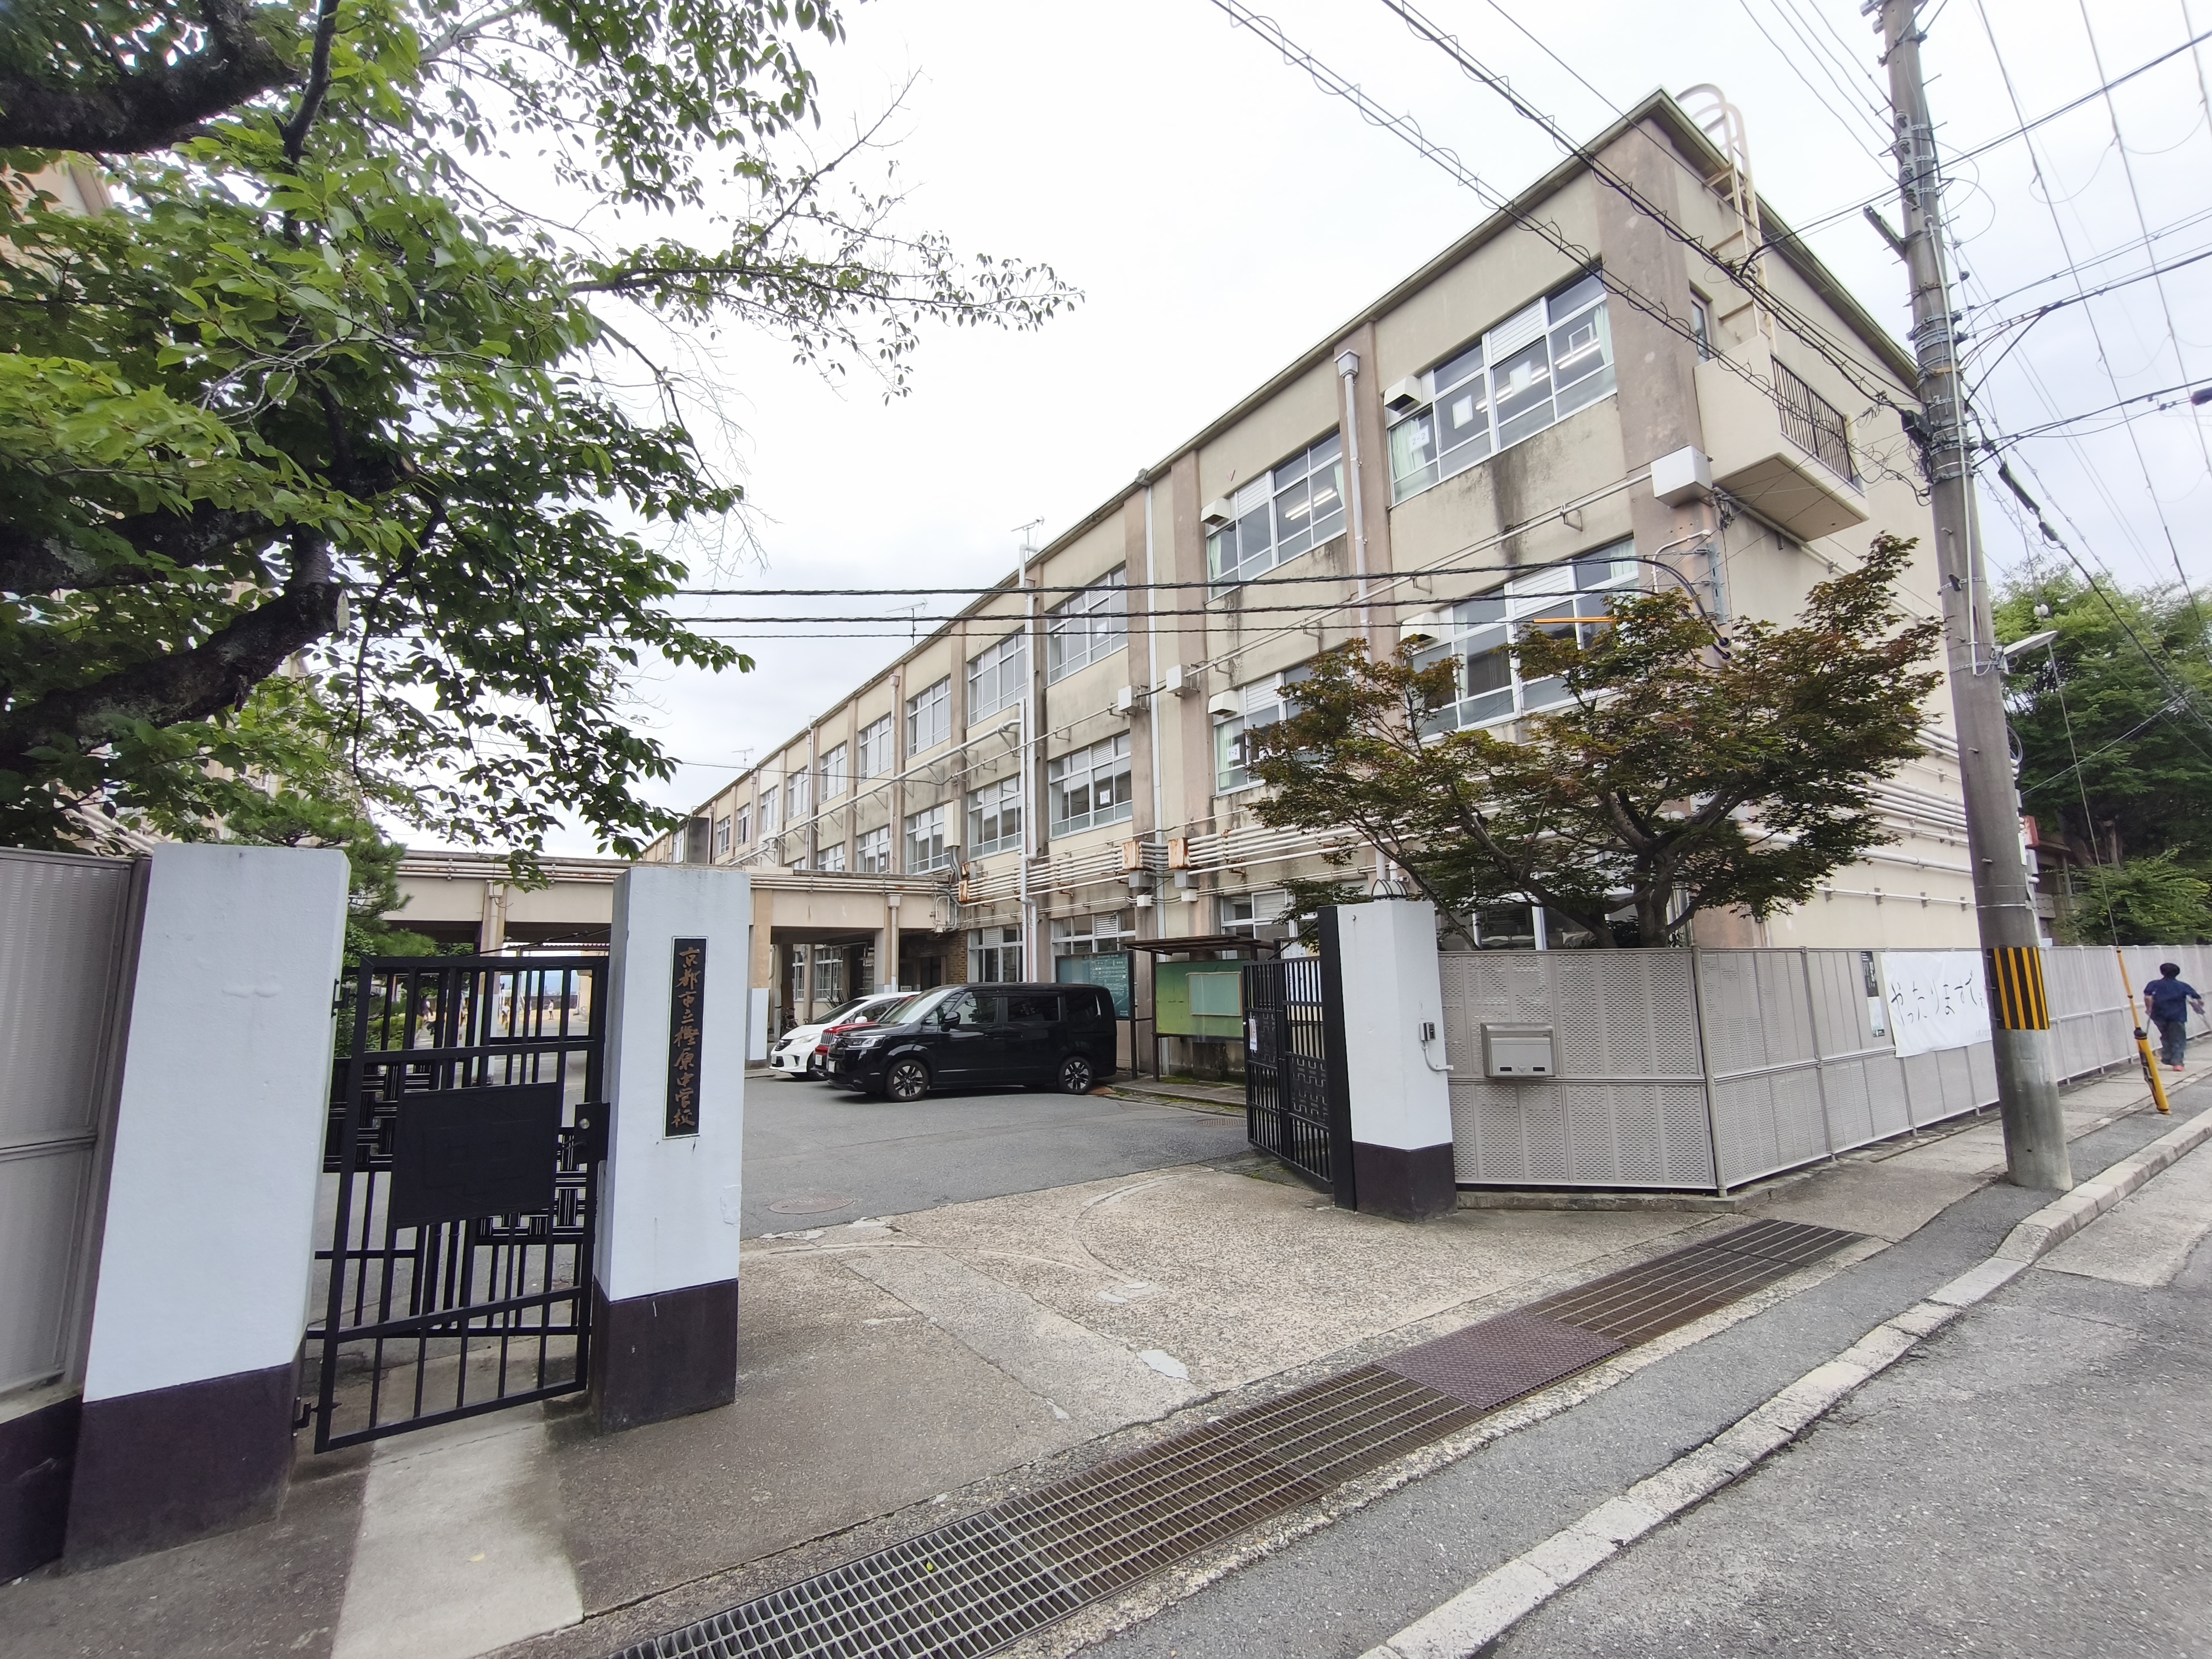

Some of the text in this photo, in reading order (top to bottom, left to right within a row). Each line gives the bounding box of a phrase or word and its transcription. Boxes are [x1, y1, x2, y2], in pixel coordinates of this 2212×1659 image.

[1411, 432, 1426, 446] 2-2
[1228, 748, 1238, 757] 1-2
[671, 946, 701, 1128] 京都市立樫原中学校
